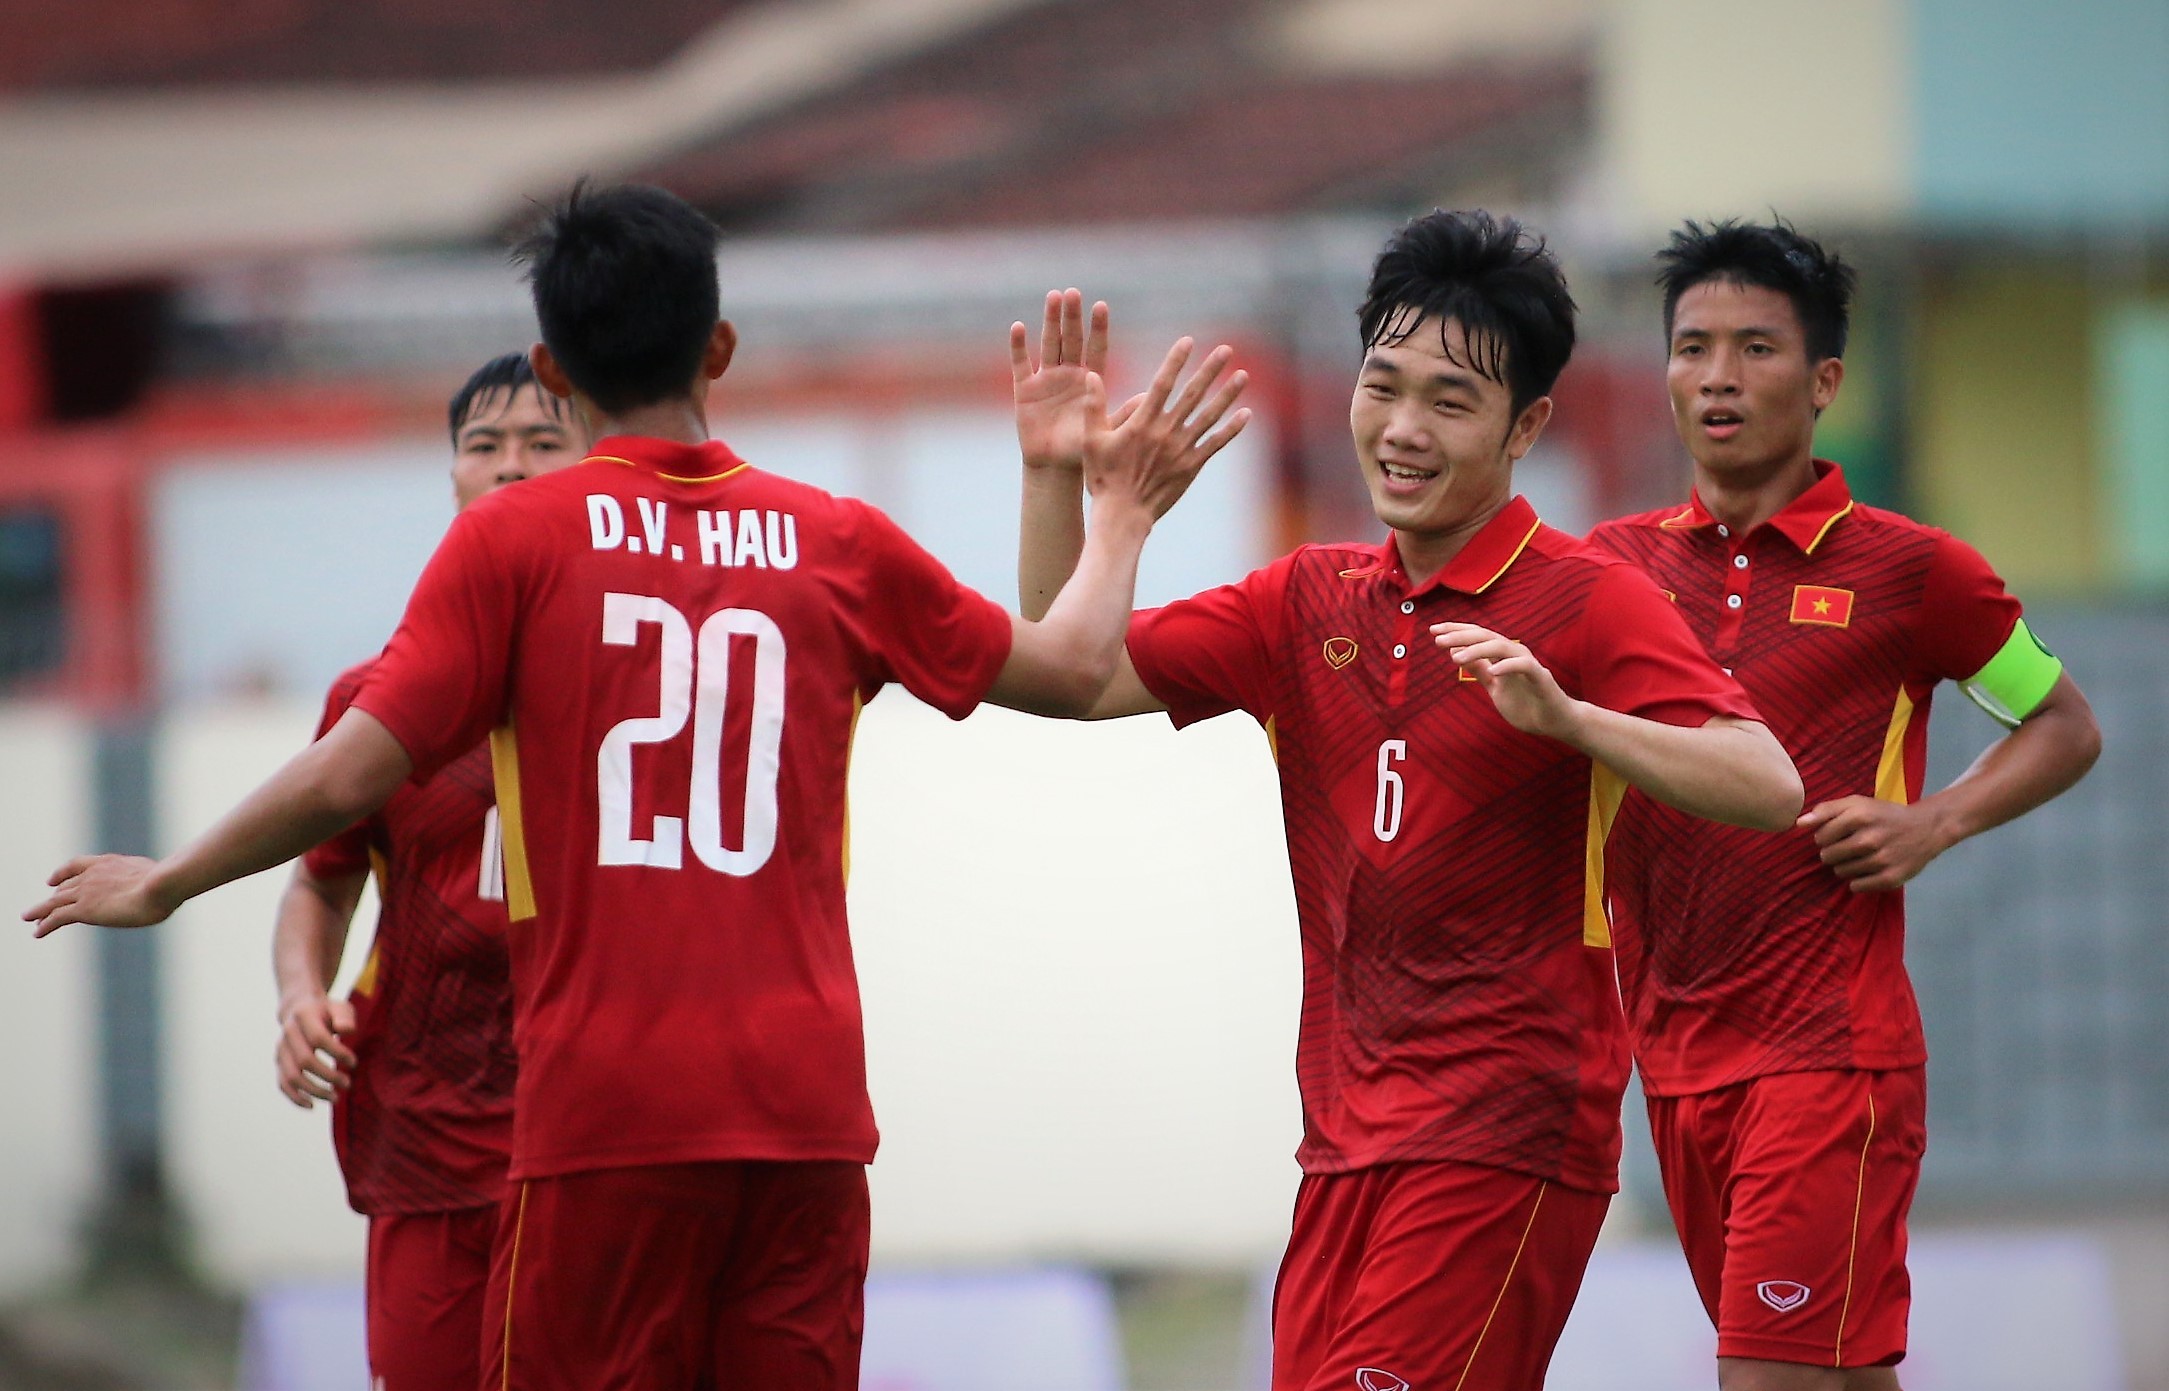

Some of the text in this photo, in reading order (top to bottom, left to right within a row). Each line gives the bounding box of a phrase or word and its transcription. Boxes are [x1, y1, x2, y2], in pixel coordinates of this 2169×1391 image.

[586, 494, 798, 570] D.V. HAU
[597, 591, 787, 877] 20
[1373, 739, 1407, 842] 6
